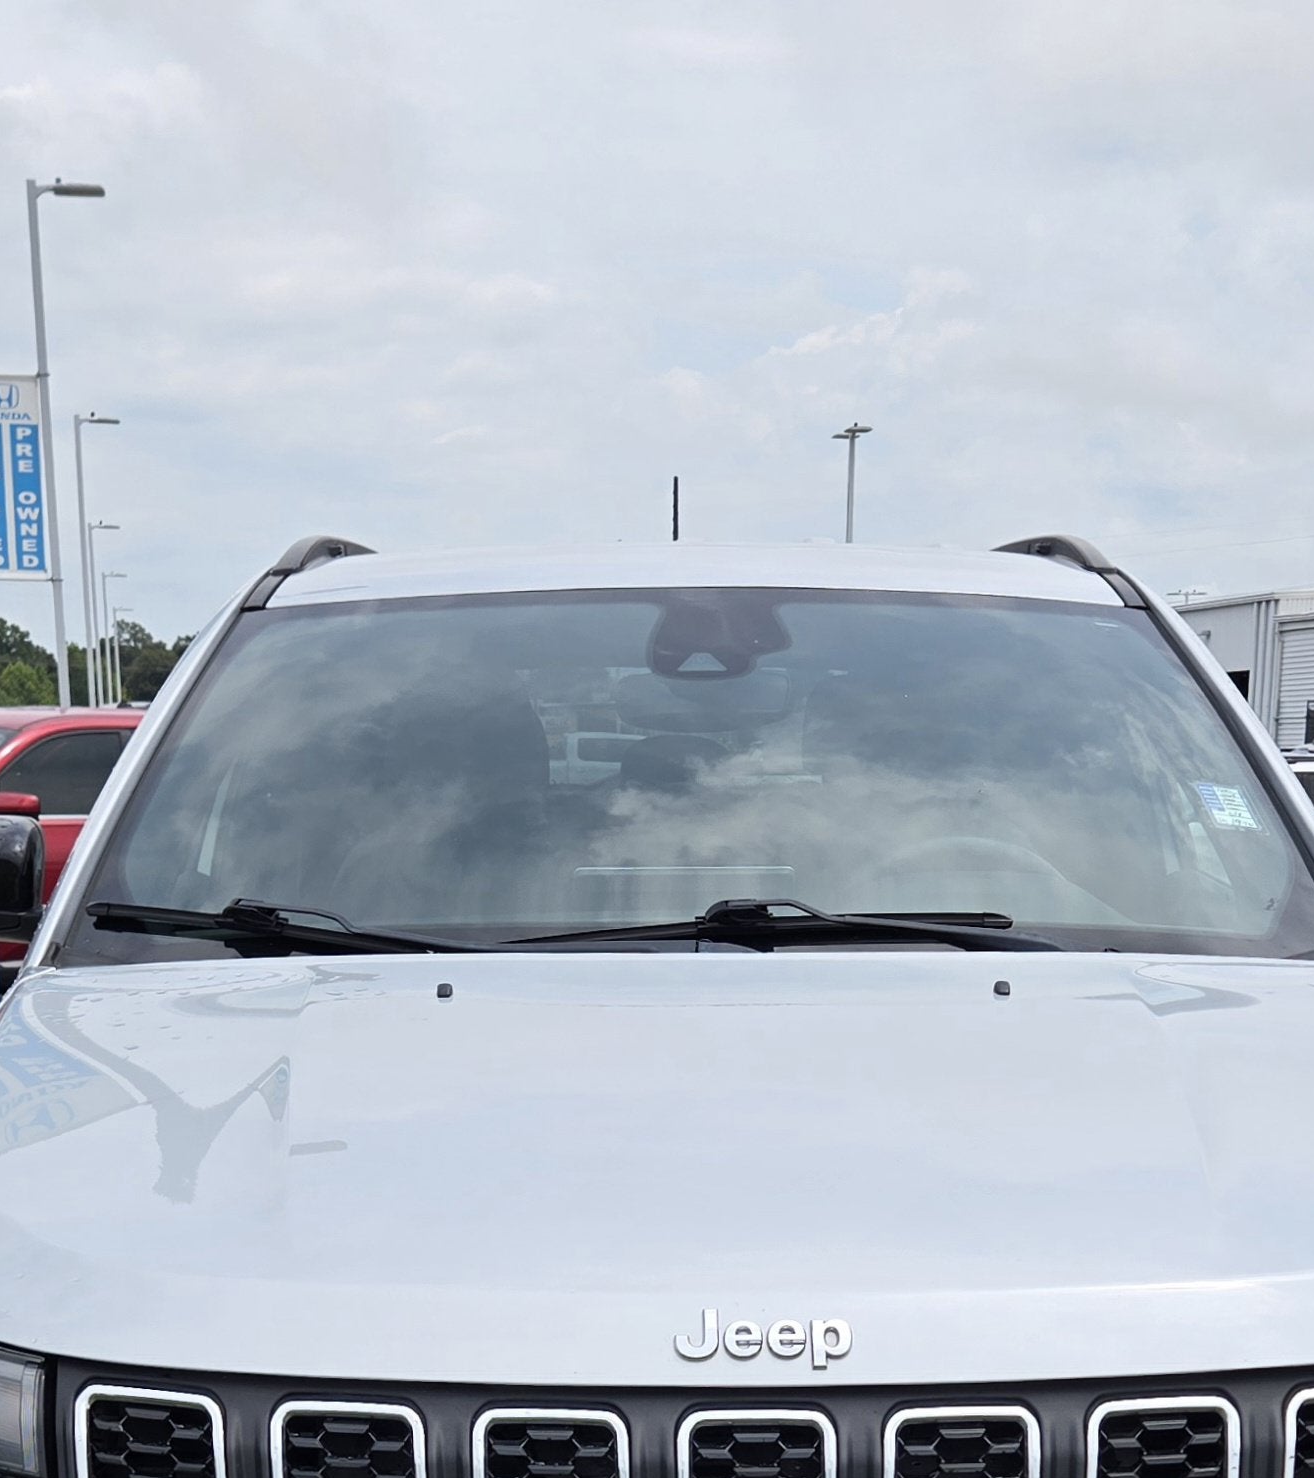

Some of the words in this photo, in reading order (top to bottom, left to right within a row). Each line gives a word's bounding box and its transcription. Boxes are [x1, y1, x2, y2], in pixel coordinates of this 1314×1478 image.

[15, 427, 34, 473] PRE
[16, 491, 40, 568] OWNED
[673, 1308, 853, 1371] Jeep
